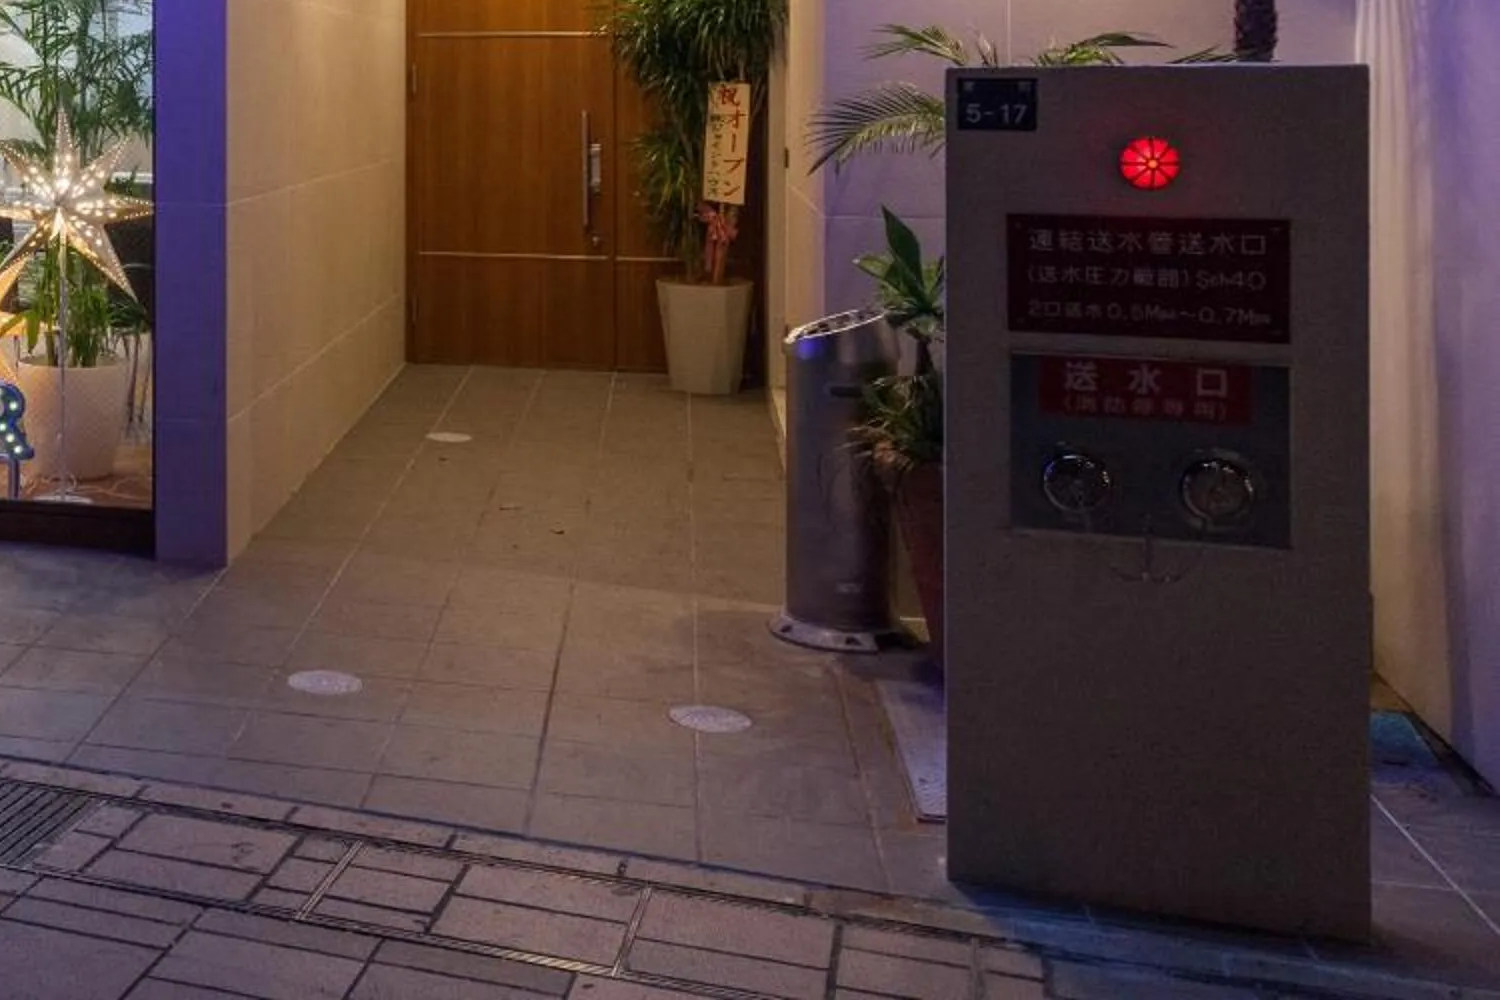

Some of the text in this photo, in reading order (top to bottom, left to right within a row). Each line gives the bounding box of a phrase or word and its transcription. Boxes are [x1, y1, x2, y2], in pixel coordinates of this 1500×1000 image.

[965, 103, 1028, 125] 5-17
[1064, 360, 1228, 398] 送水口
